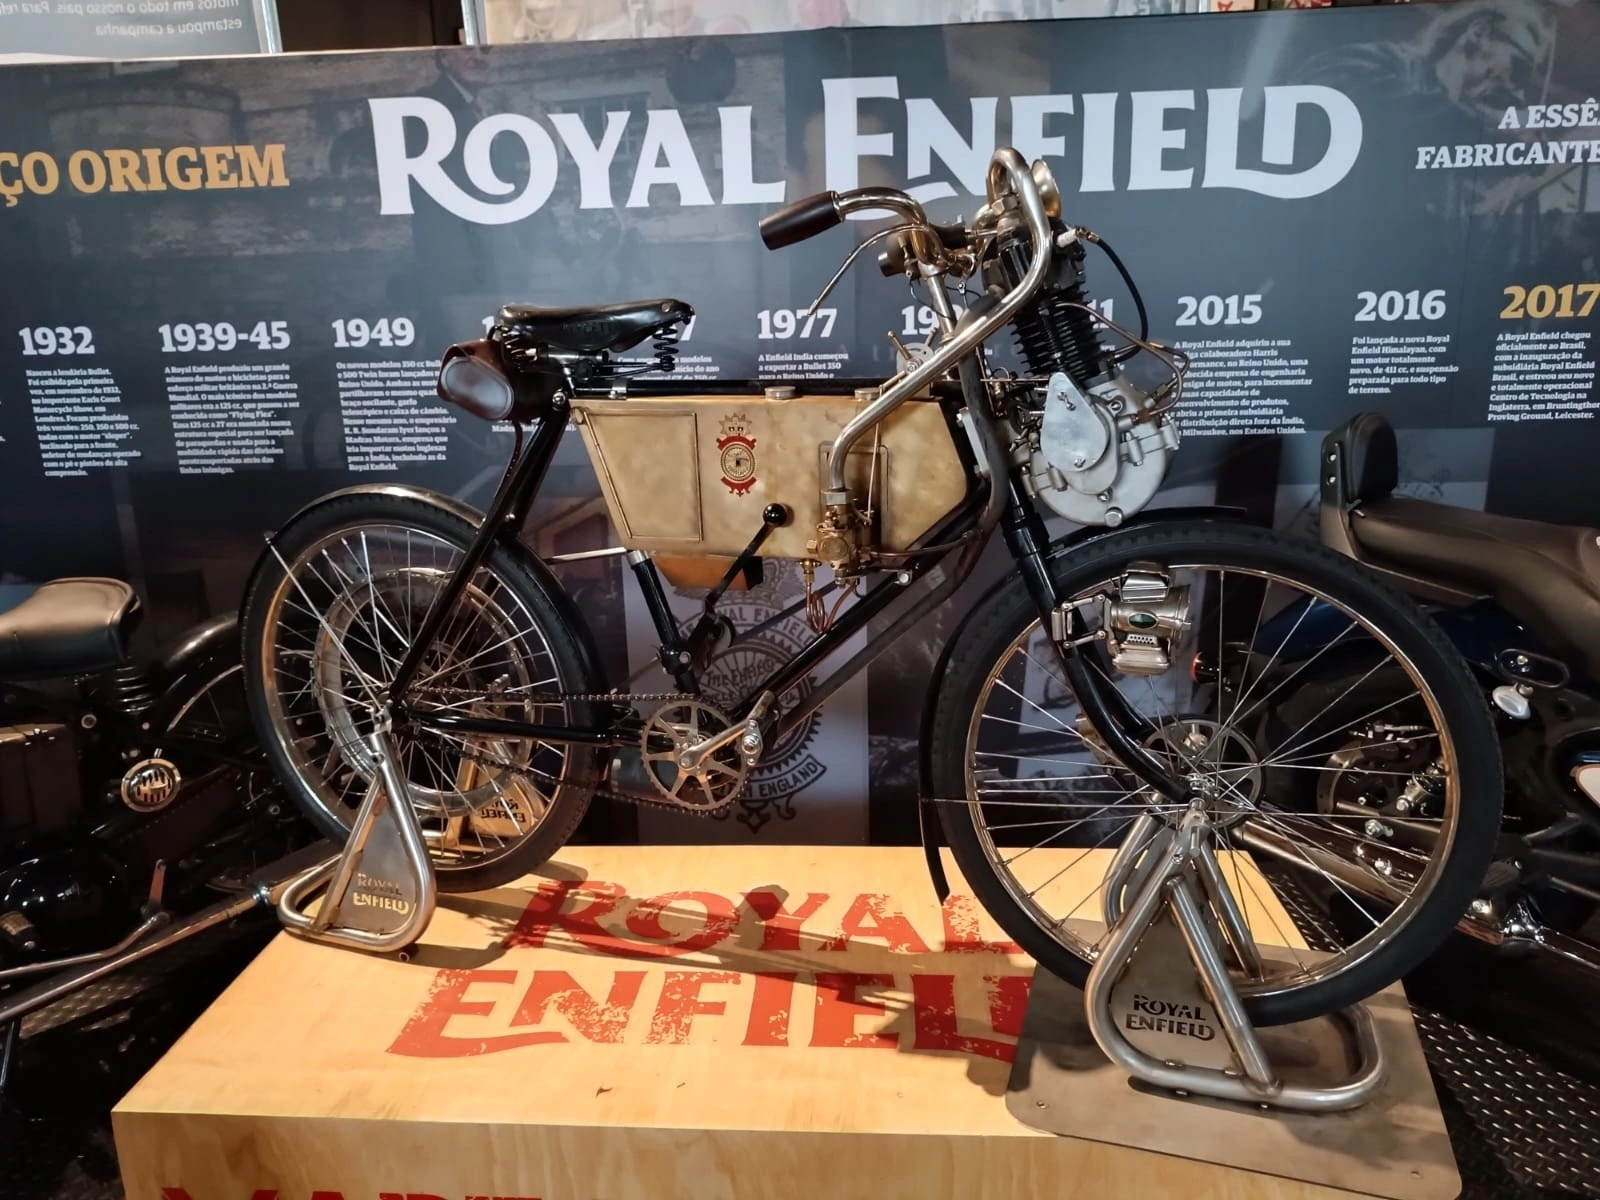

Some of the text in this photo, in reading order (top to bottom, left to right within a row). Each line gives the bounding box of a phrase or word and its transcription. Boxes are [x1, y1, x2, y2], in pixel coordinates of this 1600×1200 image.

[1498, 97, 1600, 130] A ESSÊ
[368, 76, 1363, 224] ROYAL ENFIELD
[1416, 140, 1600, 170] FABRICANTE
[69, 144, 290, 194] ORIGEM
[1354, 289, 1447, 322] 2016
[1499, 283, 1600, 319] 2017
[1175, 294, 1262, 326] 2015
[757, 308, 837, 339] 1977
[159, 321, 291, 353] 1939-45
[332, 317, 415, 348] 1949
[1505, 333, 1528, 342] Royal
[1530, 332, 1559, 340] Enfield
[1561, 332, 1591, 340] chegou
[19, 326, 95, 355] 1932
[1182, 341, 1204, 349] Royal
[1206, 340, 1234, 348] Enfield
[1236, 339, 1269, 348] adquiriu
[1367, 336, 1398, 345] lançada
[1426, 335, 1450, 344] Royal
[1352, 346, 1380, 354] Enfield
[1382, 346, 1427, 354] Himalayan,
[1496, 343, 1547, 351] oficialmente
[1560, 342, 1586, 350] Brasil,
[765, 353, 792, 361] Enfield
[814, 353, 848, 361] começou
[1200, 350, 1252, 358] colaboradora
[1253, 349, 1278, 357] Harris
[1520, 352, 1570, 361] inauguração
[764, 364, 796, 372] exportar
[827, 362, 841, 370] 350
[1263, 358, 1289, 366] Unido,
[1493, 361, 1595, 371] subsidiária Royal Enfield
[1261, 368, 1306, 377] engenharia
[1416, 366, 1459, 374] suspensão
[1349, 376, 1390, 385] preparada
[1430, 376, 1446, 384] tipo
[1492, 373, 1518, 381] Brasil,
[1183, 380, 1204, 389] esign
[1244, 379, 1262, 387] para
[1497, 383, 1542, 391] totalmente
[1543, 382, 1592, 391] operacional
[1200, 389, 1248, 398] capacidades
[1530, 392, 1575, 400] Tecnologia
[1251, 398, 1289, 407] produtos,
[1489, 403, 1531, 412] Inglaterra,
[1546, 402, 1600, 410] Bruntingthor
[1176, 409, 1197, 417] abriu
[1204, 408, 1238, 417] primeira
[1488, 411, 1594, 422] Proving Ground, Leicester.
[1181, 418, 1228, 427] distribuição
[1229, 418, 1252, 426] direta
[1254, 417, 1270, 425] fora
[1282, 416, 1305, 424] Índia,
[759, 761, 818, 797] ENGLAND
[357, 872, 403, 895] ROYAL
[353, 891, 409, 915] ENFIELD
[506, 880, 1025, 957] ROYAL
[1133, 994, 1207, 1021] ROYAL
[1126, 1013, 1216, 1041] ENFIELD
